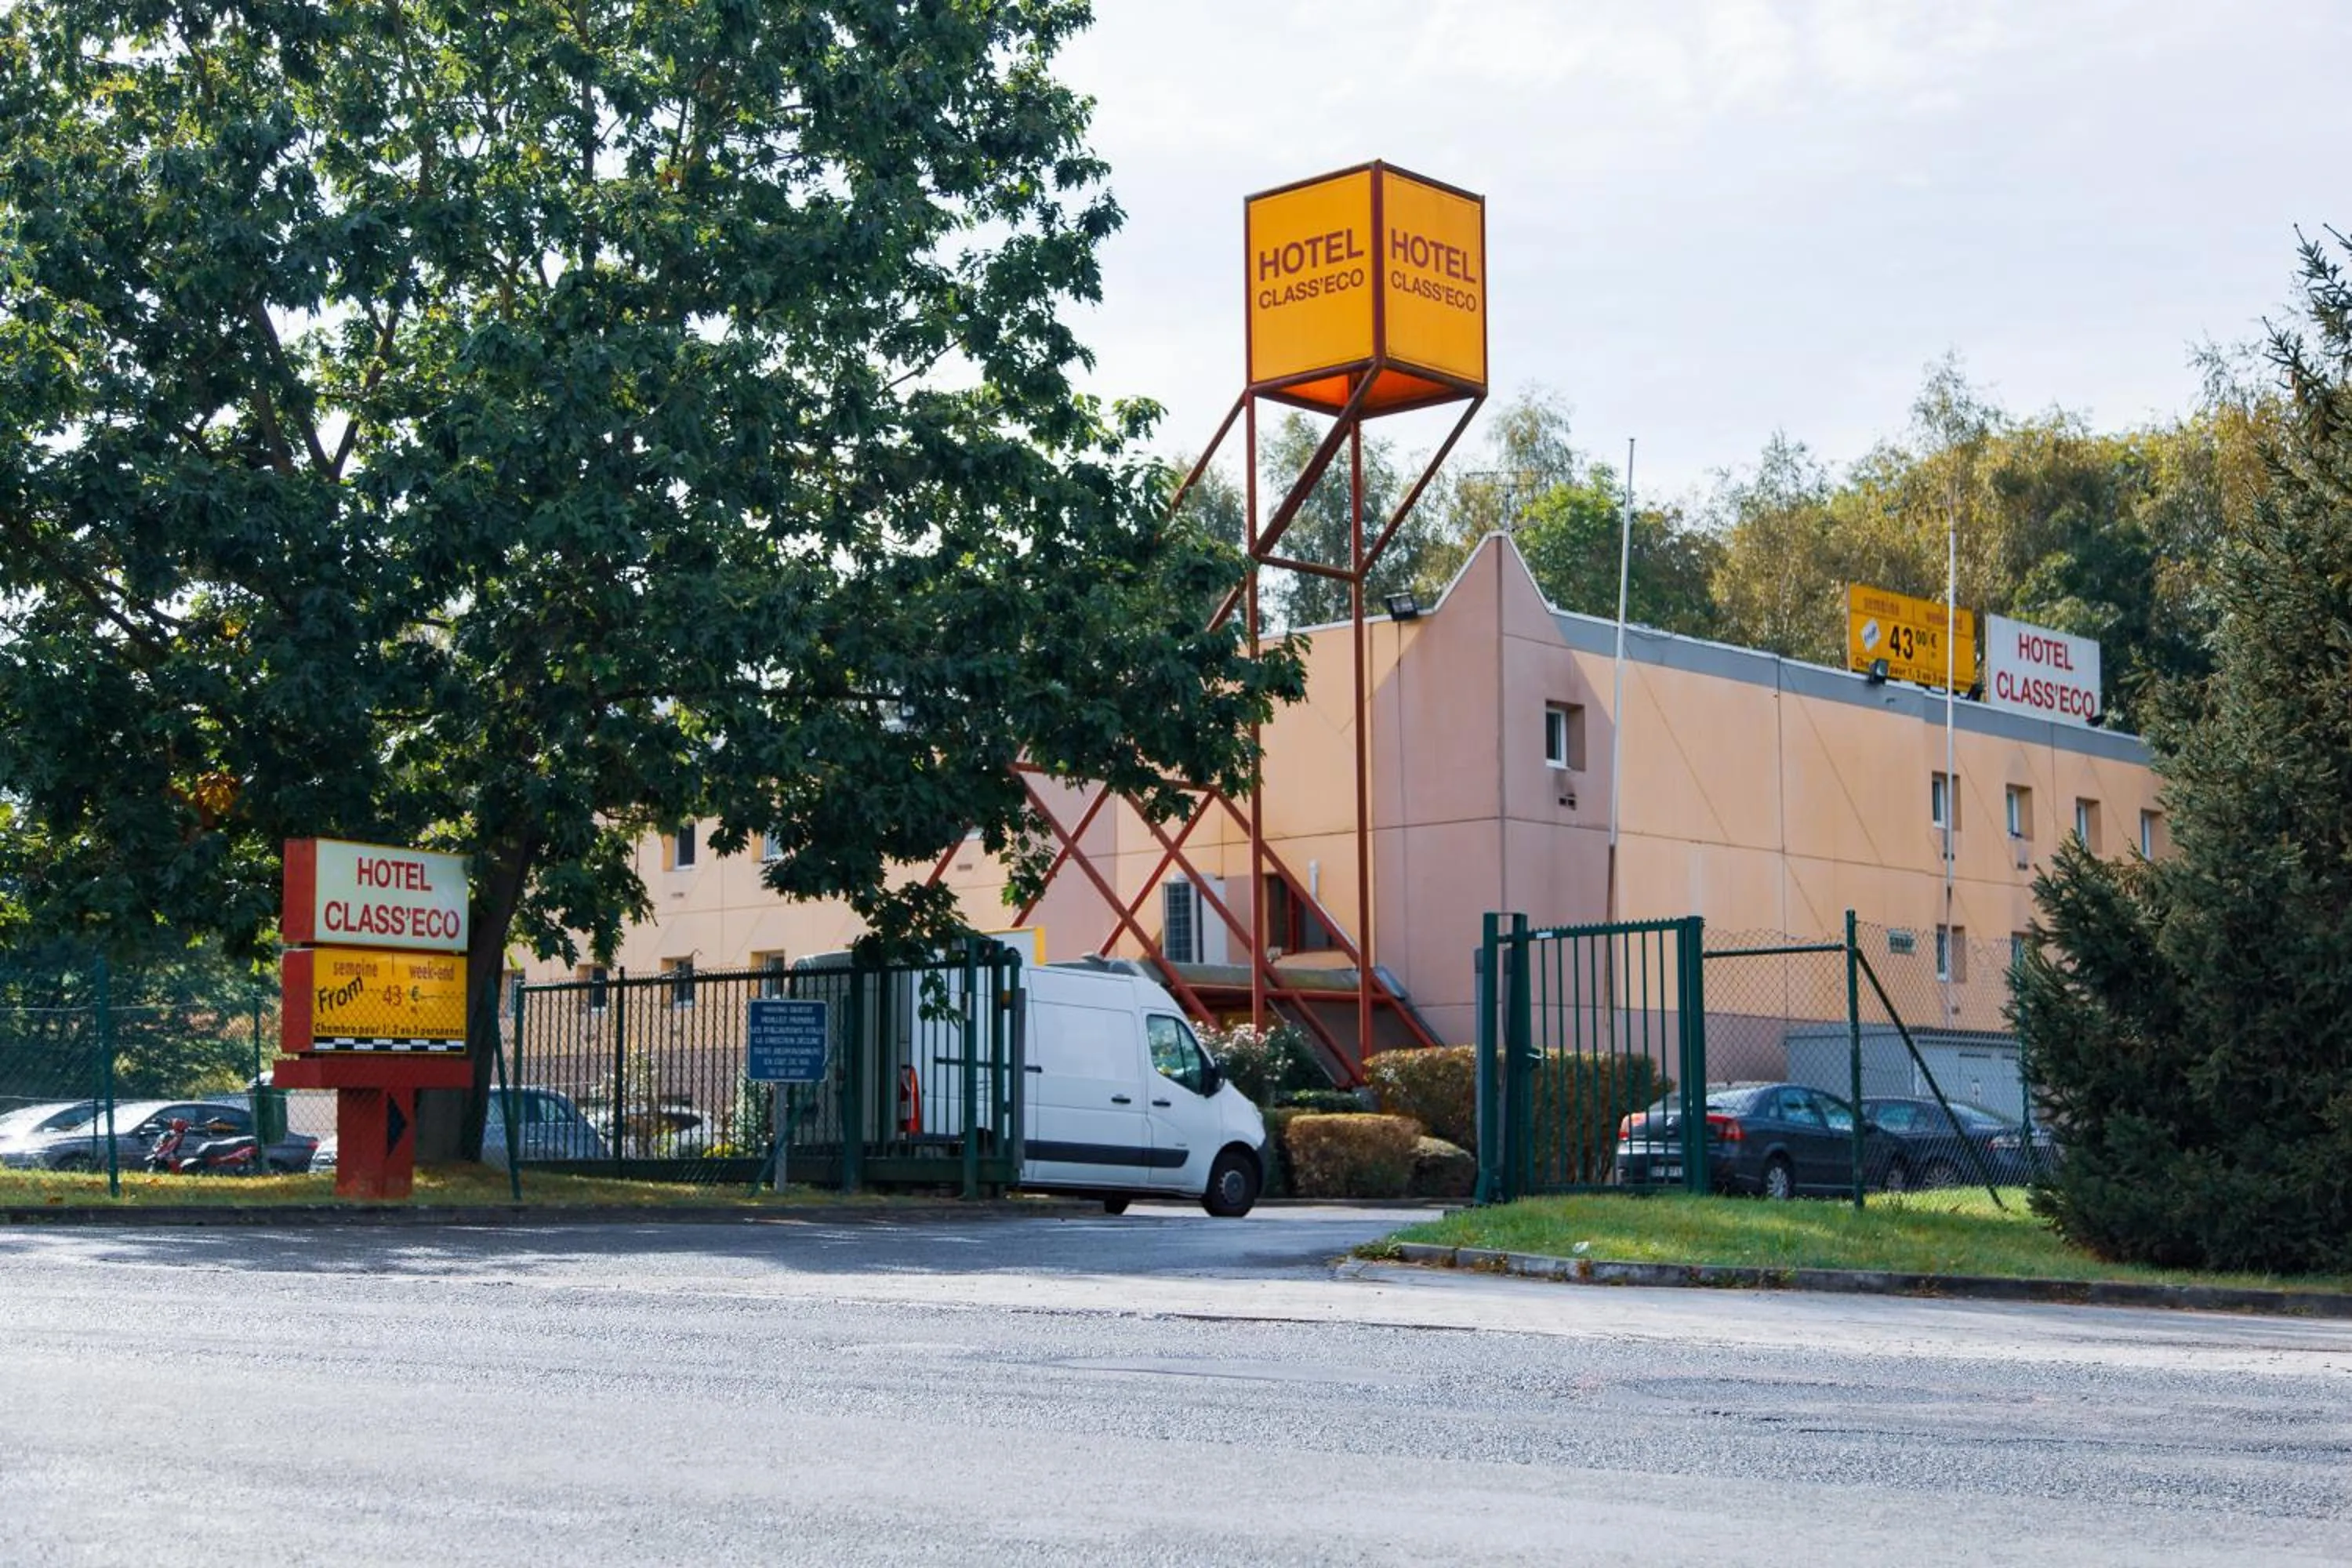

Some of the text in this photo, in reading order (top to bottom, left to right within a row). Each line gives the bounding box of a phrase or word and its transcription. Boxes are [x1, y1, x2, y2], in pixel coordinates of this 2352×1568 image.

[1258, 228, 1364, 282] HOTEL
[1390, 228, 1477, 284] HOTEL
[1258, 268, 1364, 310] CLASS'ECO
[1390, 270, 1477, 313] CLASS'ECO
[1889, 625, 1914, 660] 43
[2018, 633, 2074, 670] HOTEL
[1996, 671, 2096, 720] CLASS'ECO
[356, 857, 432, 891] HOTEL
[324, 901, 460, 939] CLASS'ECO
[333, 958, 378, 978] semaine
[318, 976, 364, 1014] From
[383, 985, 403, 1007] 43
